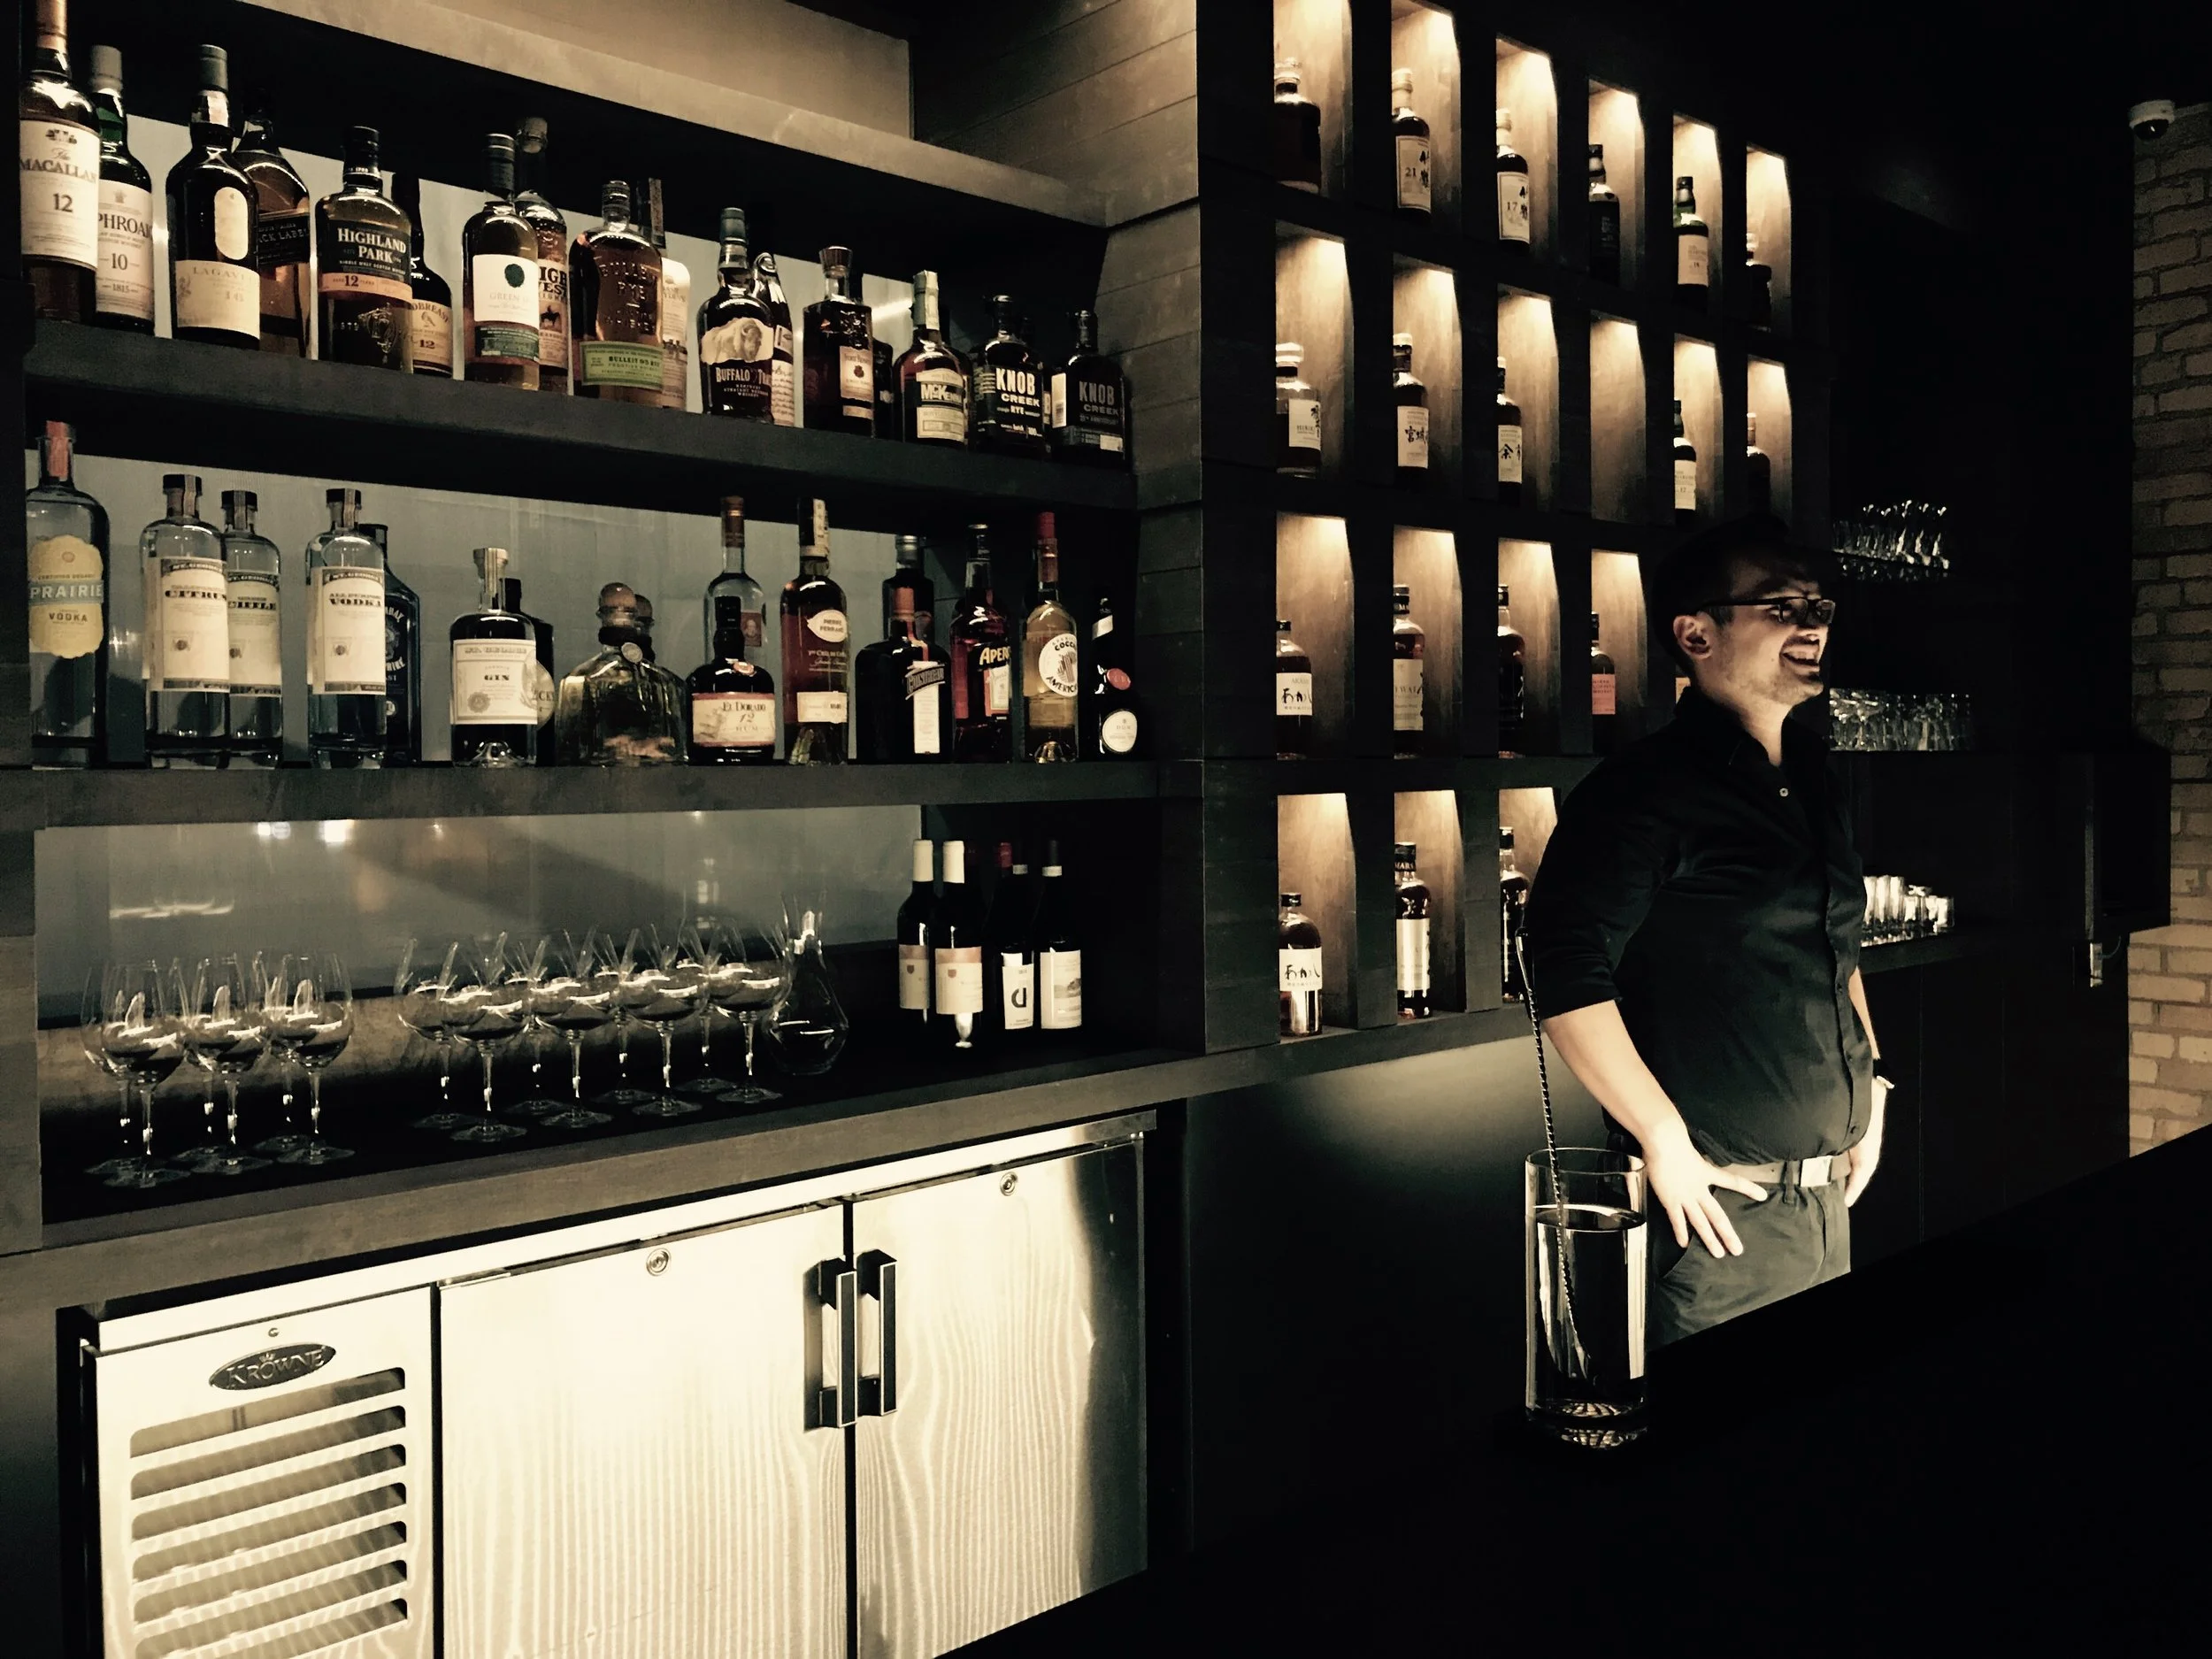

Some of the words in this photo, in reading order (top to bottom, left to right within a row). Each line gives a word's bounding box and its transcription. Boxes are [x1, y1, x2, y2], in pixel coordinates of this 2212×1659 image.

[19, 158, 97, 184] MACALLAN
[1404, 166, 1417, 178] 21
[53, 193, 73, 212] 12
[1507, 201, 1518, 211] 17
[337, 227, 407, 254] HIGHLAND
[358, 245, 394, 264] PARK
[111, 253, 128, 271] 10
[344, 274, 359, 287] 12
[112, 283, 130, 294] 1815
[420, 339, 436, 349] 12
[715, 366, 750, 383] BUFFALO
[995, 367, 1035, 396] KNOB
[1001, 393, 1041, 407] CREEK
[1079, 380, 1115, 406] KNOB
[1083, 403, 1119, 416] CREEK
[30, 584, 103, 599] PRAIRIE
[330, 598, 381, 607] VODKA
[49, 612, 88, 622] VODKA
[740, 712, 755, 723] 12
[227, 1351, 326, 1386] KROWNE
